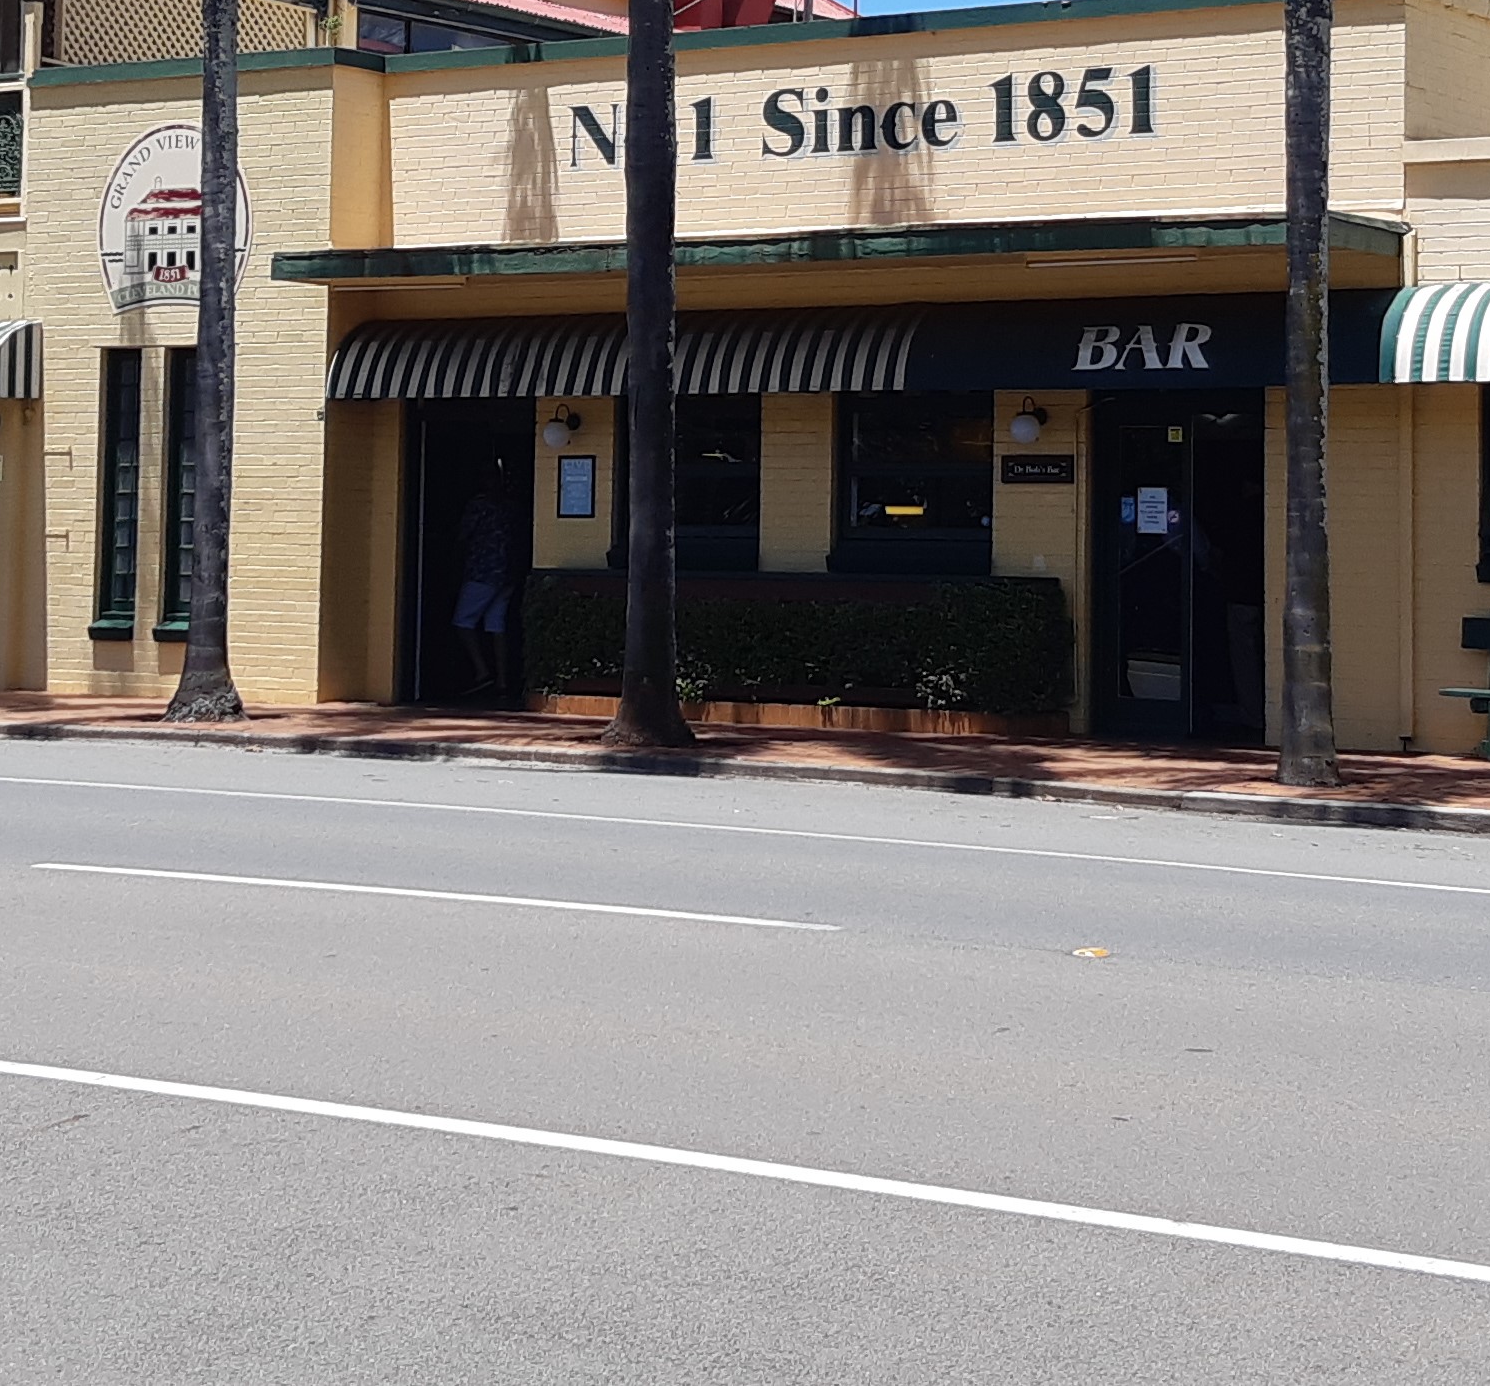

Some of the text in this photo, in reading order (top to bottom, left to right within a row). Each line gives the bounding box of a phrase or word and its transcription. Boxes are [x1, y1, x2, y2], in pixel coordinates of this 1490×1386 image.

[761, 87, 958, 158] Since
[988, 64, 1154, 144] 1851
[110, 134, 201, 209] GRAND VIEW
[117, 283, 185, 302] CLEVELAND
[1071, 323, 1211, 370] BAR
